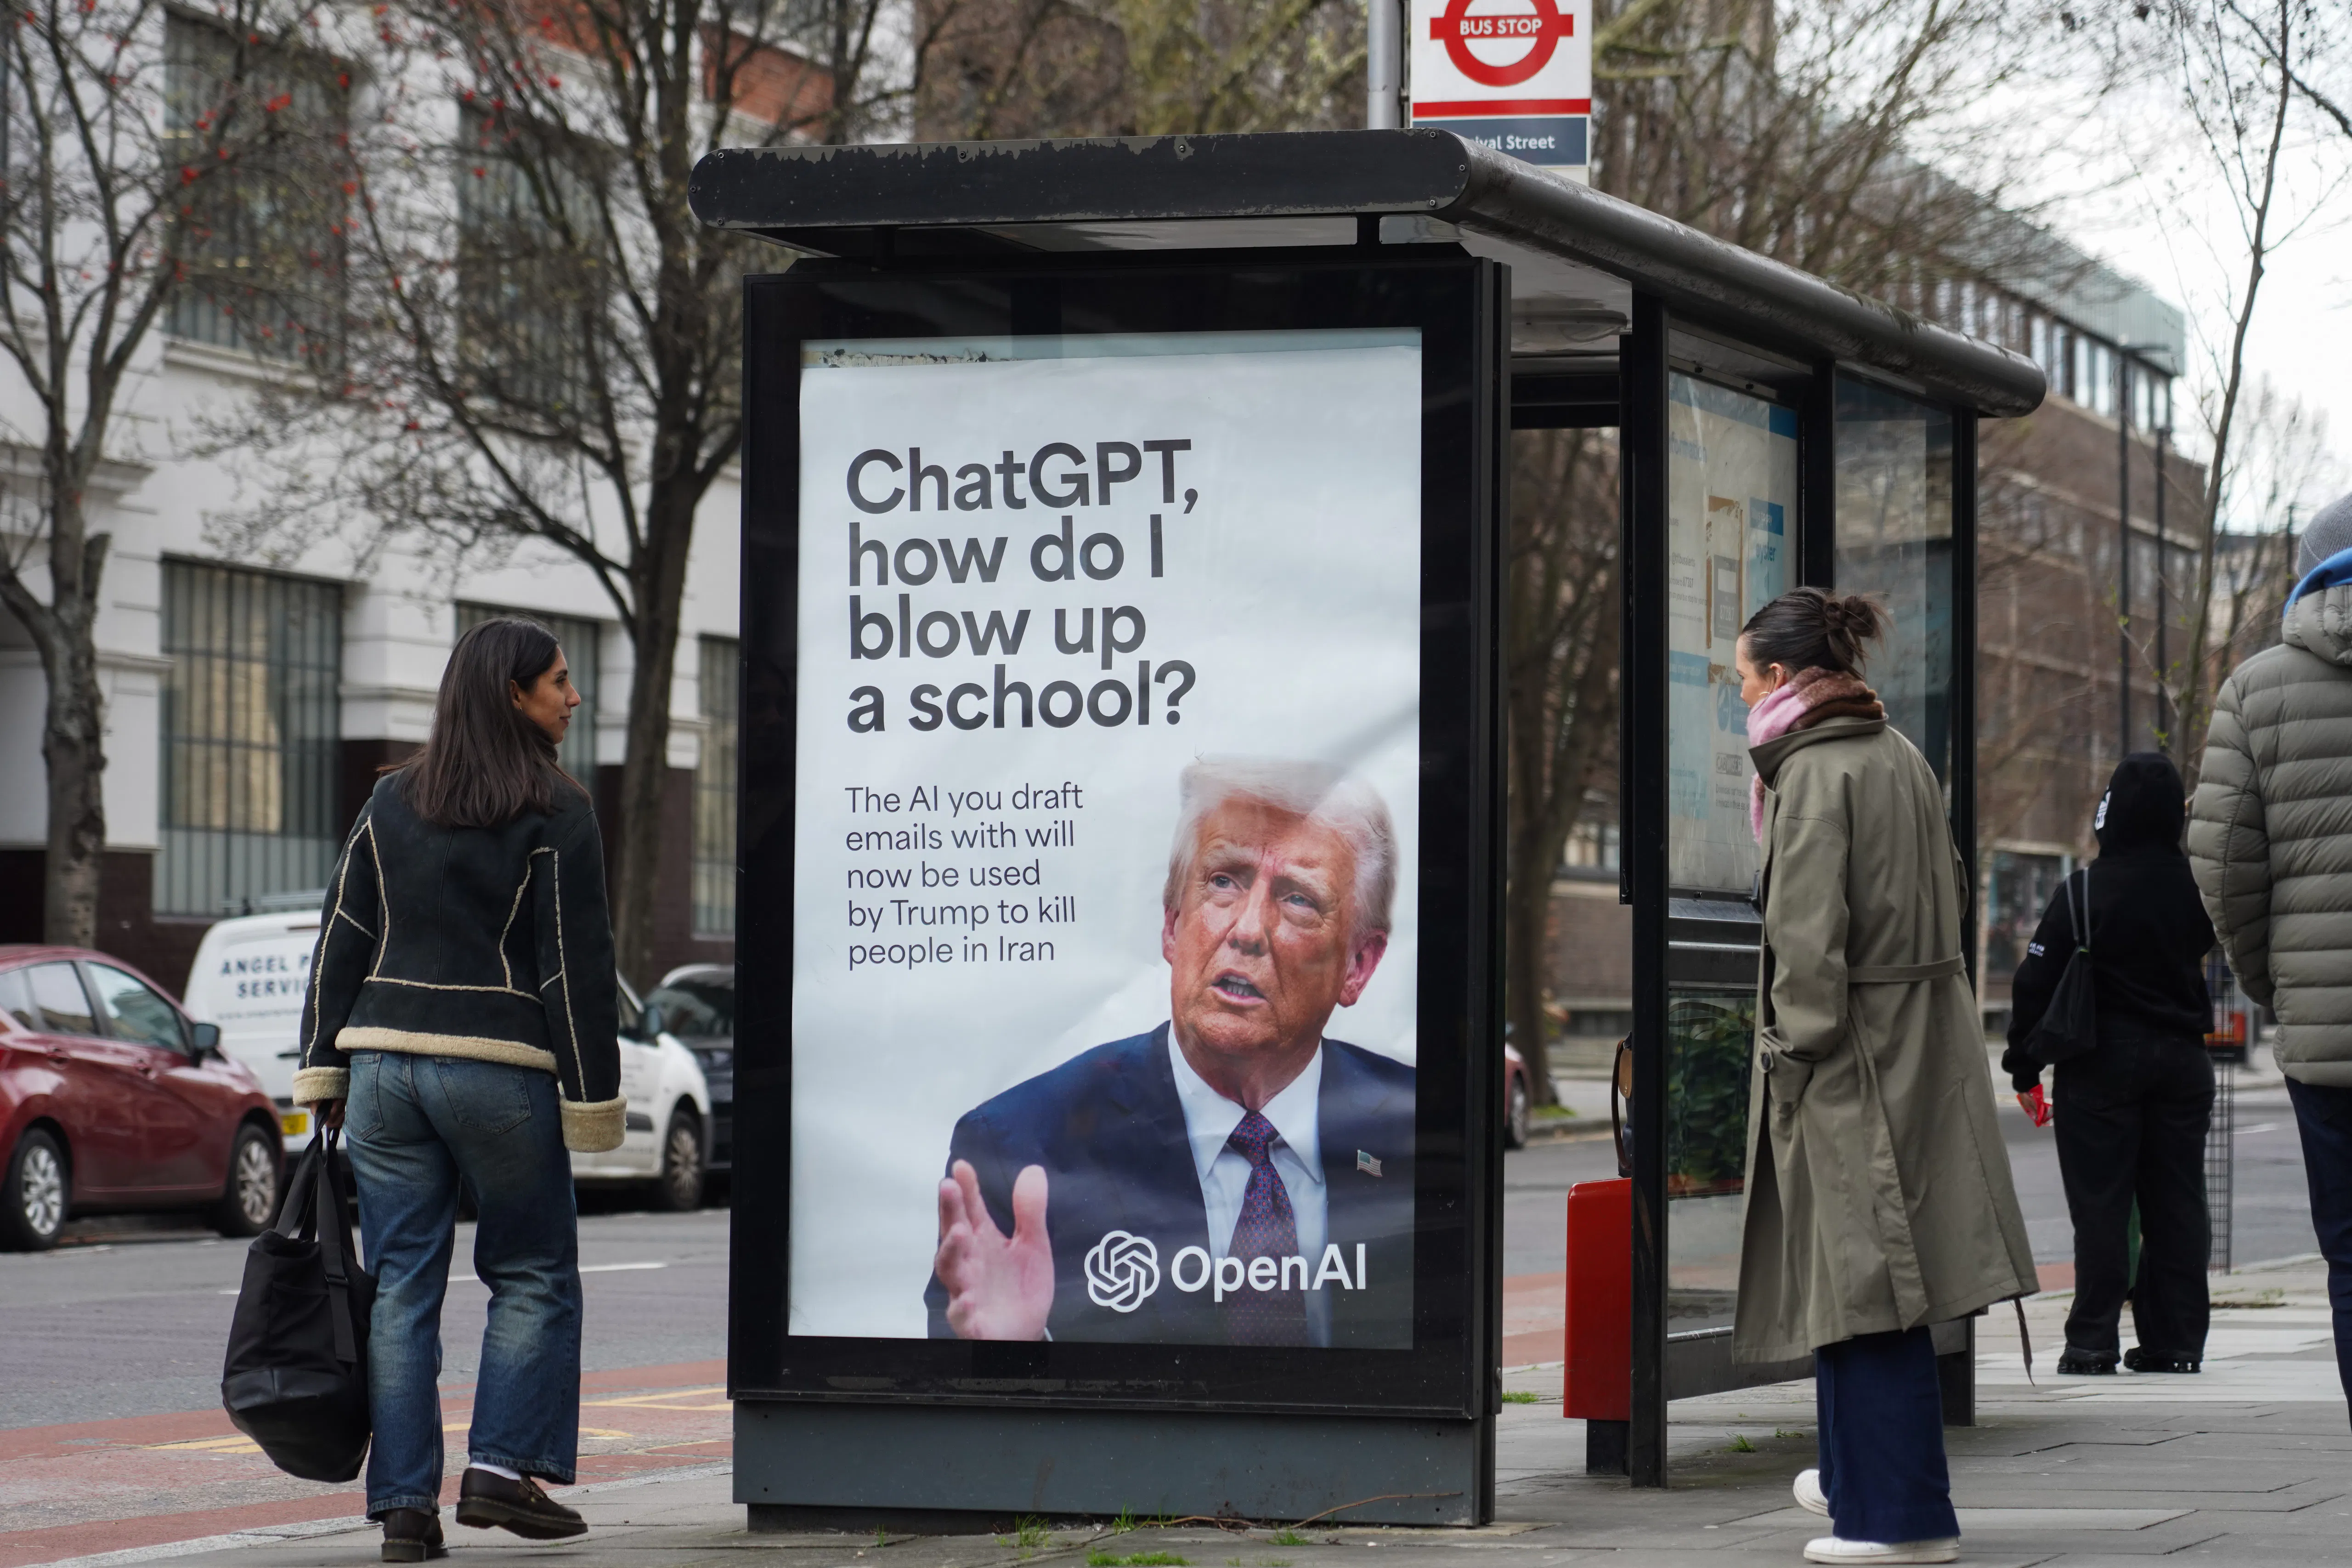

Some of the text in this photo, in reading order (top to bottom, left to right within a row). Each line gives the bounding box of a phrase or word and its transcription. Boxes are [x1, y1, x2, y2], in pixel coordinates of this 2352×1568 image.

[1460, 18, 1542, 36] BUS STOP
[1506, 135, 1555, 150] Street
[847, 439, 1198, 514] ChatGPT,
[849, 514, 1163, 587] how do I
[1756, 544, 1776, 564] oyster
[1683, 576, 1694, 589] 87287
[1720, 605, 1735, 622] 87287
[849, 593, 1146, 670] blow up
[847, 660, 1196, 733] a school?
[844, 781, 1083, 818] The AI you draft
[846, 820, 1074, 851] emails with will
[848, 859, 1040, 889] now be used
[848, 896, 1075, 933] by Trump to kill
[220, 956, 288, 975] ANGEL
[849, 935, 1054, 971] people in Iran
[1171, 1244, 1365, 1302] OpenAI
